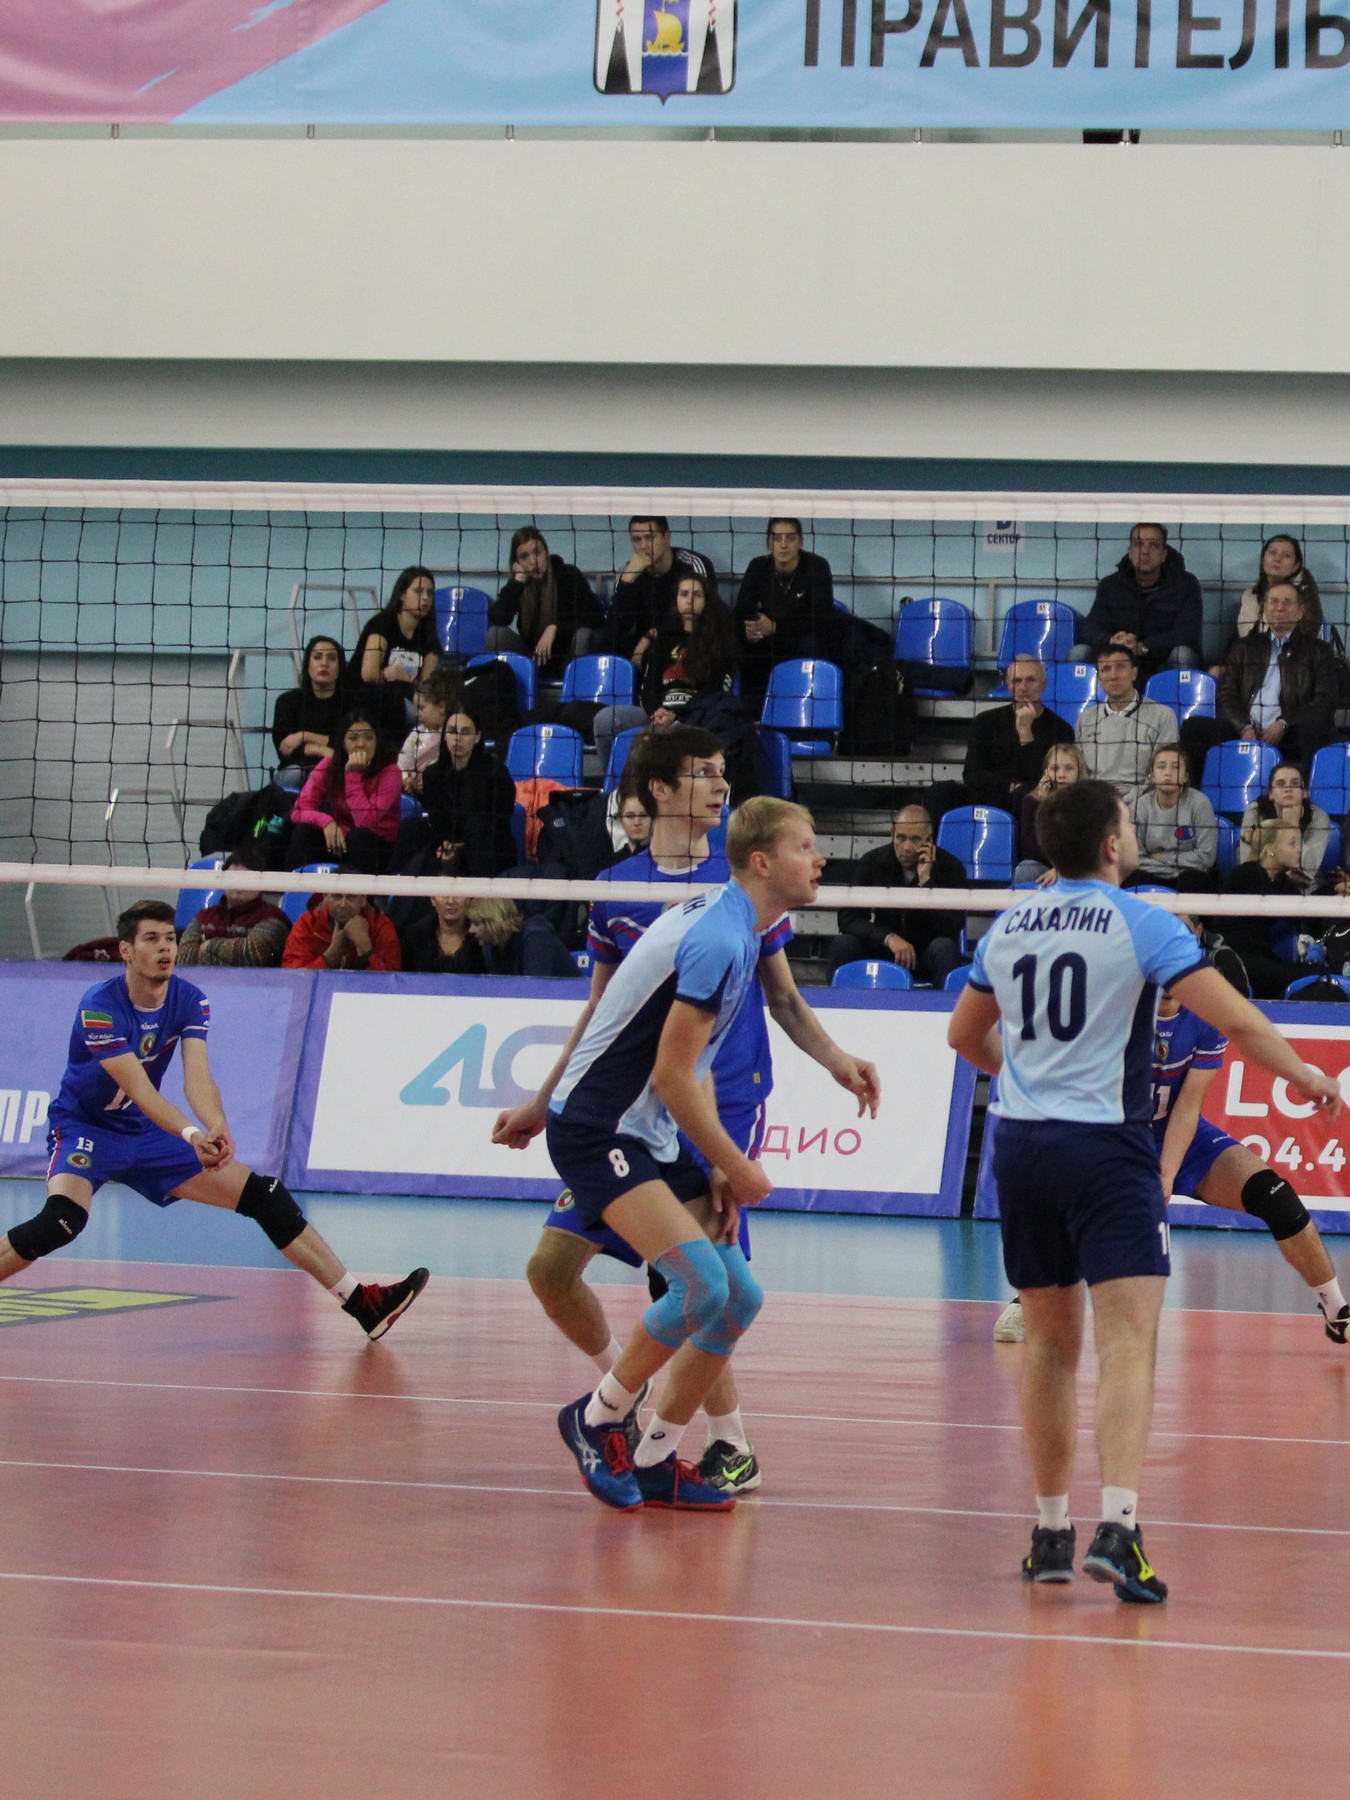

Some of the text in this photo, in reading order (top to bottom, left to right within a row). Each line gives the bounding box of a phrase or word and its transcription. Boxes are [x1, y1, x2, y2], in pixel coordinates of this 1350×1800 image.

[1005, 906, 1113, 935] САХАЛИН
[1012, 951, 1088, 1042] 10
[76, 1137, 94, 1152] 13
[608, 1148, 630, 1177] 8
